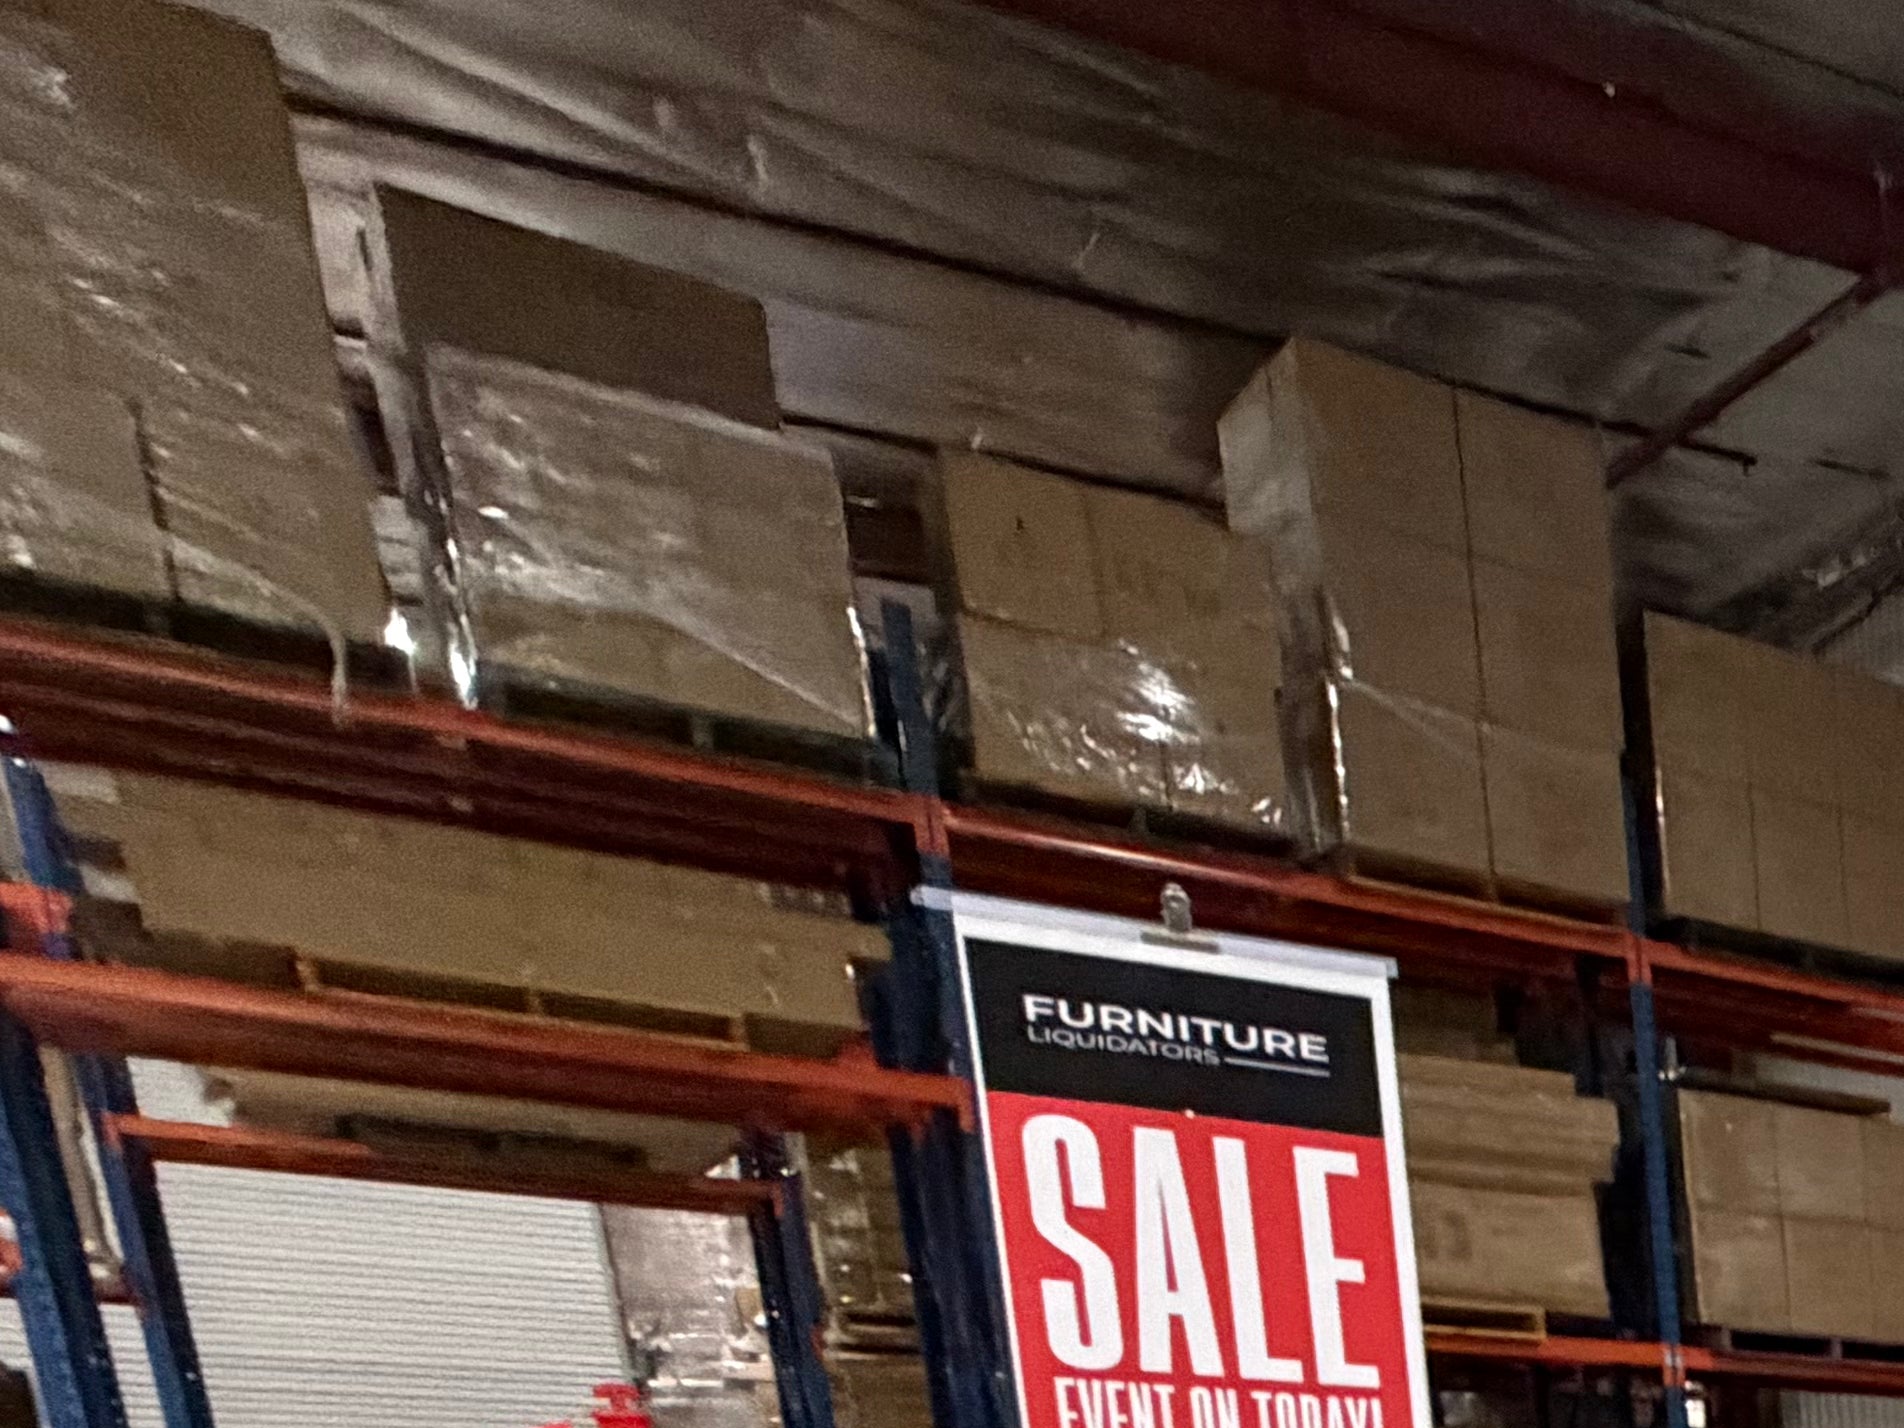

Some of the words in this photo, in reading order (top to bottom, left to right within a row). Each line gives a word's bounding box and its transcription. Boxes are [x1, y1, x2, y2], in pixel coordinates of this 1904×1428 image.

[1022, 993, 1330, 1064] FURNITURE
[1026, 1024, 1221, 1067] LIQUIDATORS
[1021, 1112, 1381, 1390] SALE
